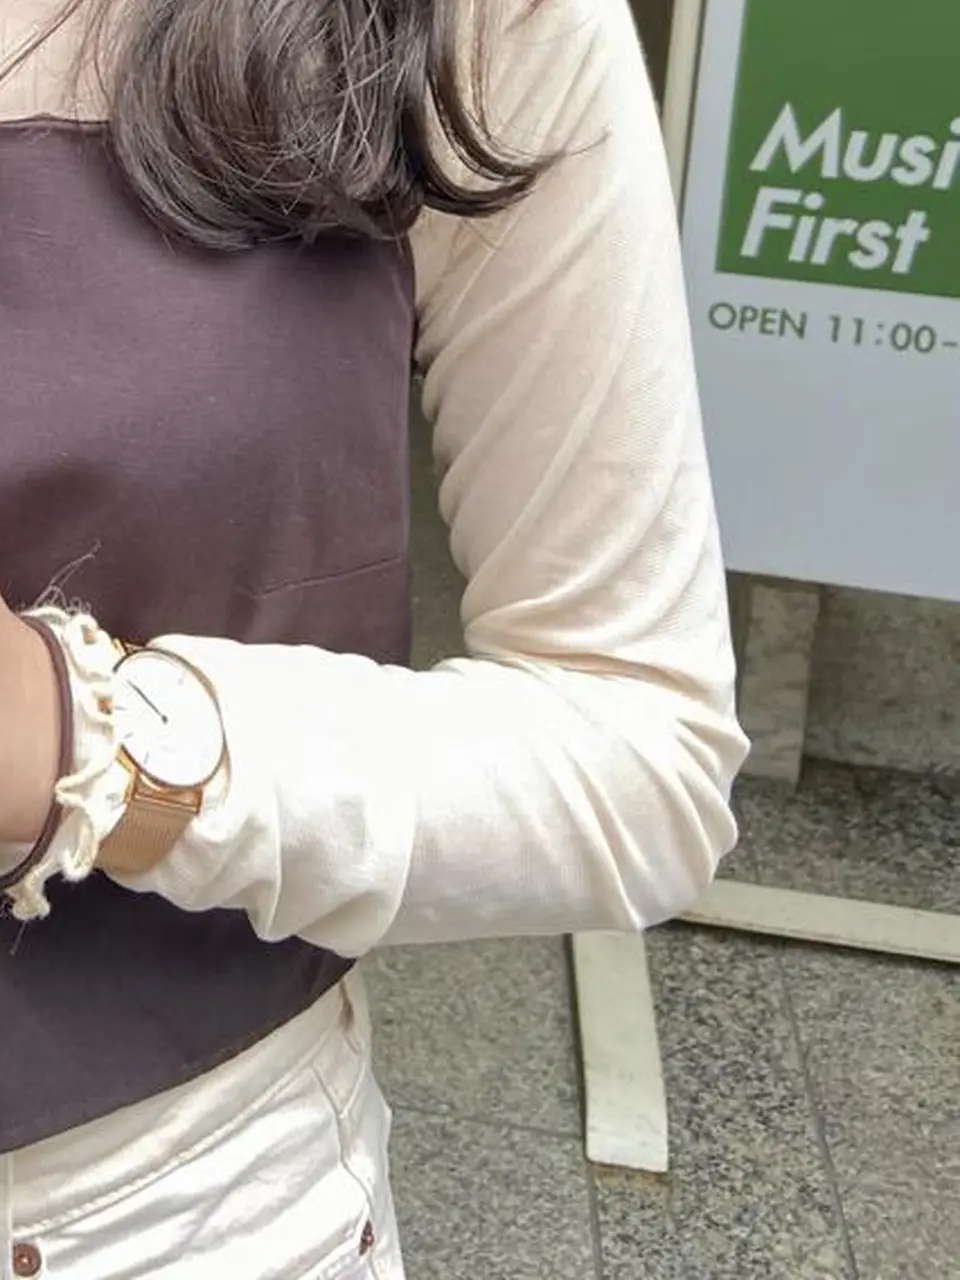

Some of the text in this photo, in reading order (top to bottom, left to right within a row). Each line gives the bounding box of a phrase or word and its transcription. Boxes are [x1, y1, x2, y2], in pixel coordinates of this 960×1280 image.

[749, 101, 960, 190] Musi
[740, 185, 930, 275] First
[708, 301, 808, 340] OPEN
